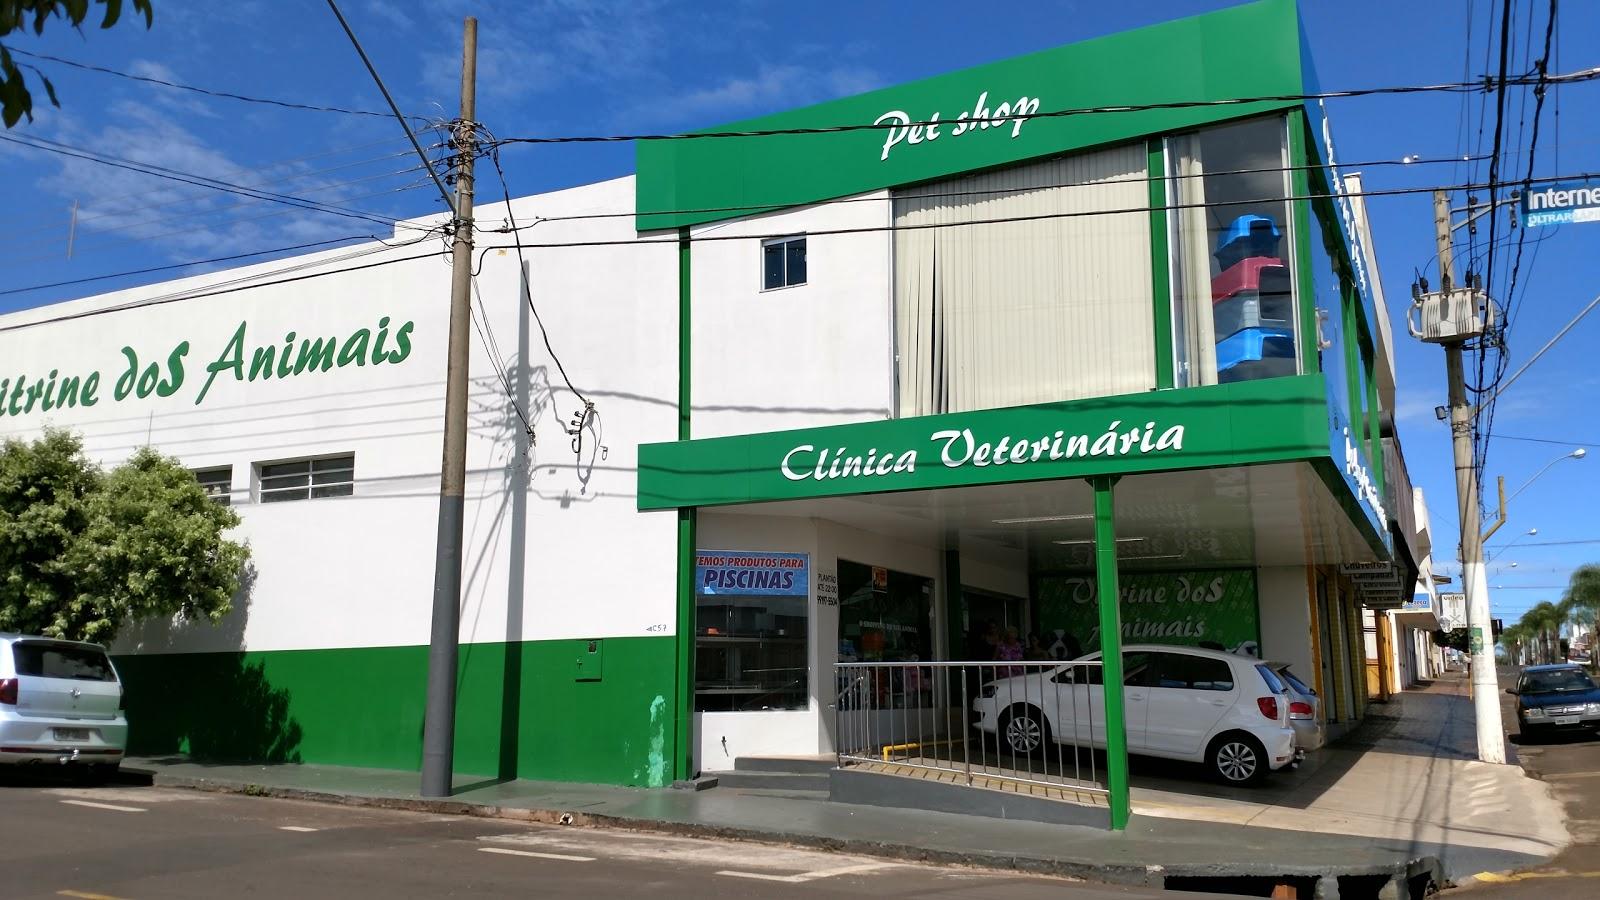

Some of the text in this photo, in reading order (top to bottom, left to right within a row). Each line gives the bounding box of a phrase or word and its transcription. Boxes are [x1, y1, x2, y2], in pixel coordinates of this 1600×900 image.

[873, 91, 1040, 161] Pet shop
[1528, 187, 1600, 210] Interne
[0, 368, 99, 417] itrine
[195, 316, 415, 405] Animais
[781, 421, 1185, 482] Clínica Veterinária
[727, 557, 777, 568] PRODUTOS
[779, 558, 804, 569] PARA
[704, 569, 794, 589] PISCINAS
[1065, 577, 1168, 604] Vrine
